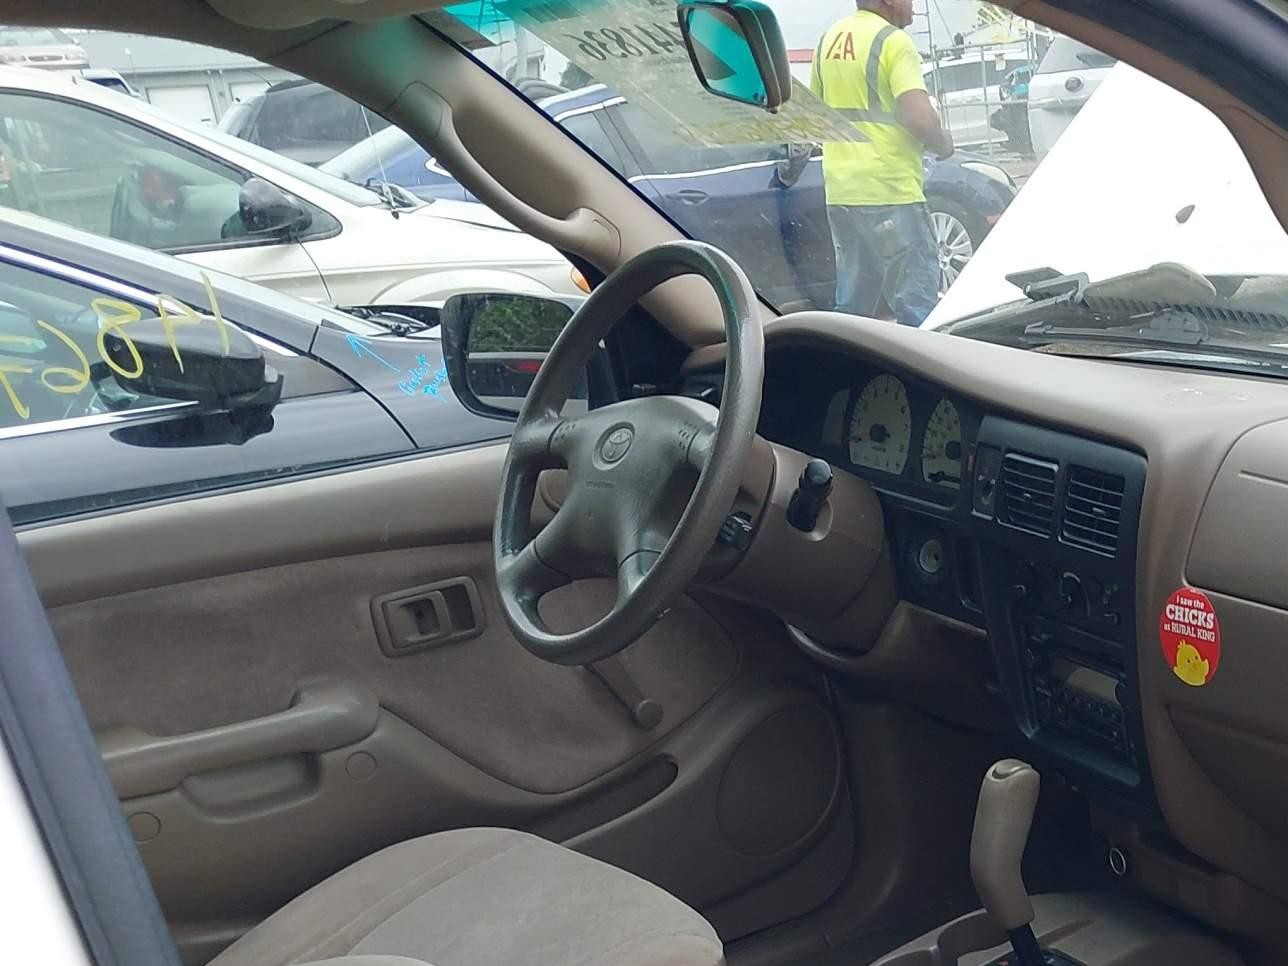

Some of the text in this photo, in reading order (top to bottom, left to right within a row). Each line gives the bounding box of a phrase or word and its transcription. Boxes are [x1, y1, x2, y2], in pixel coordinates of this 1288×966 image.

[1180, 597, 1193, 606] saw
[1193, 599, 1205, 609] the
[1165, 604, 1215, 630] CHICKS
[1171, 621, 1196, 638] RURAL
[1197, 628, 1216, 643] KING
